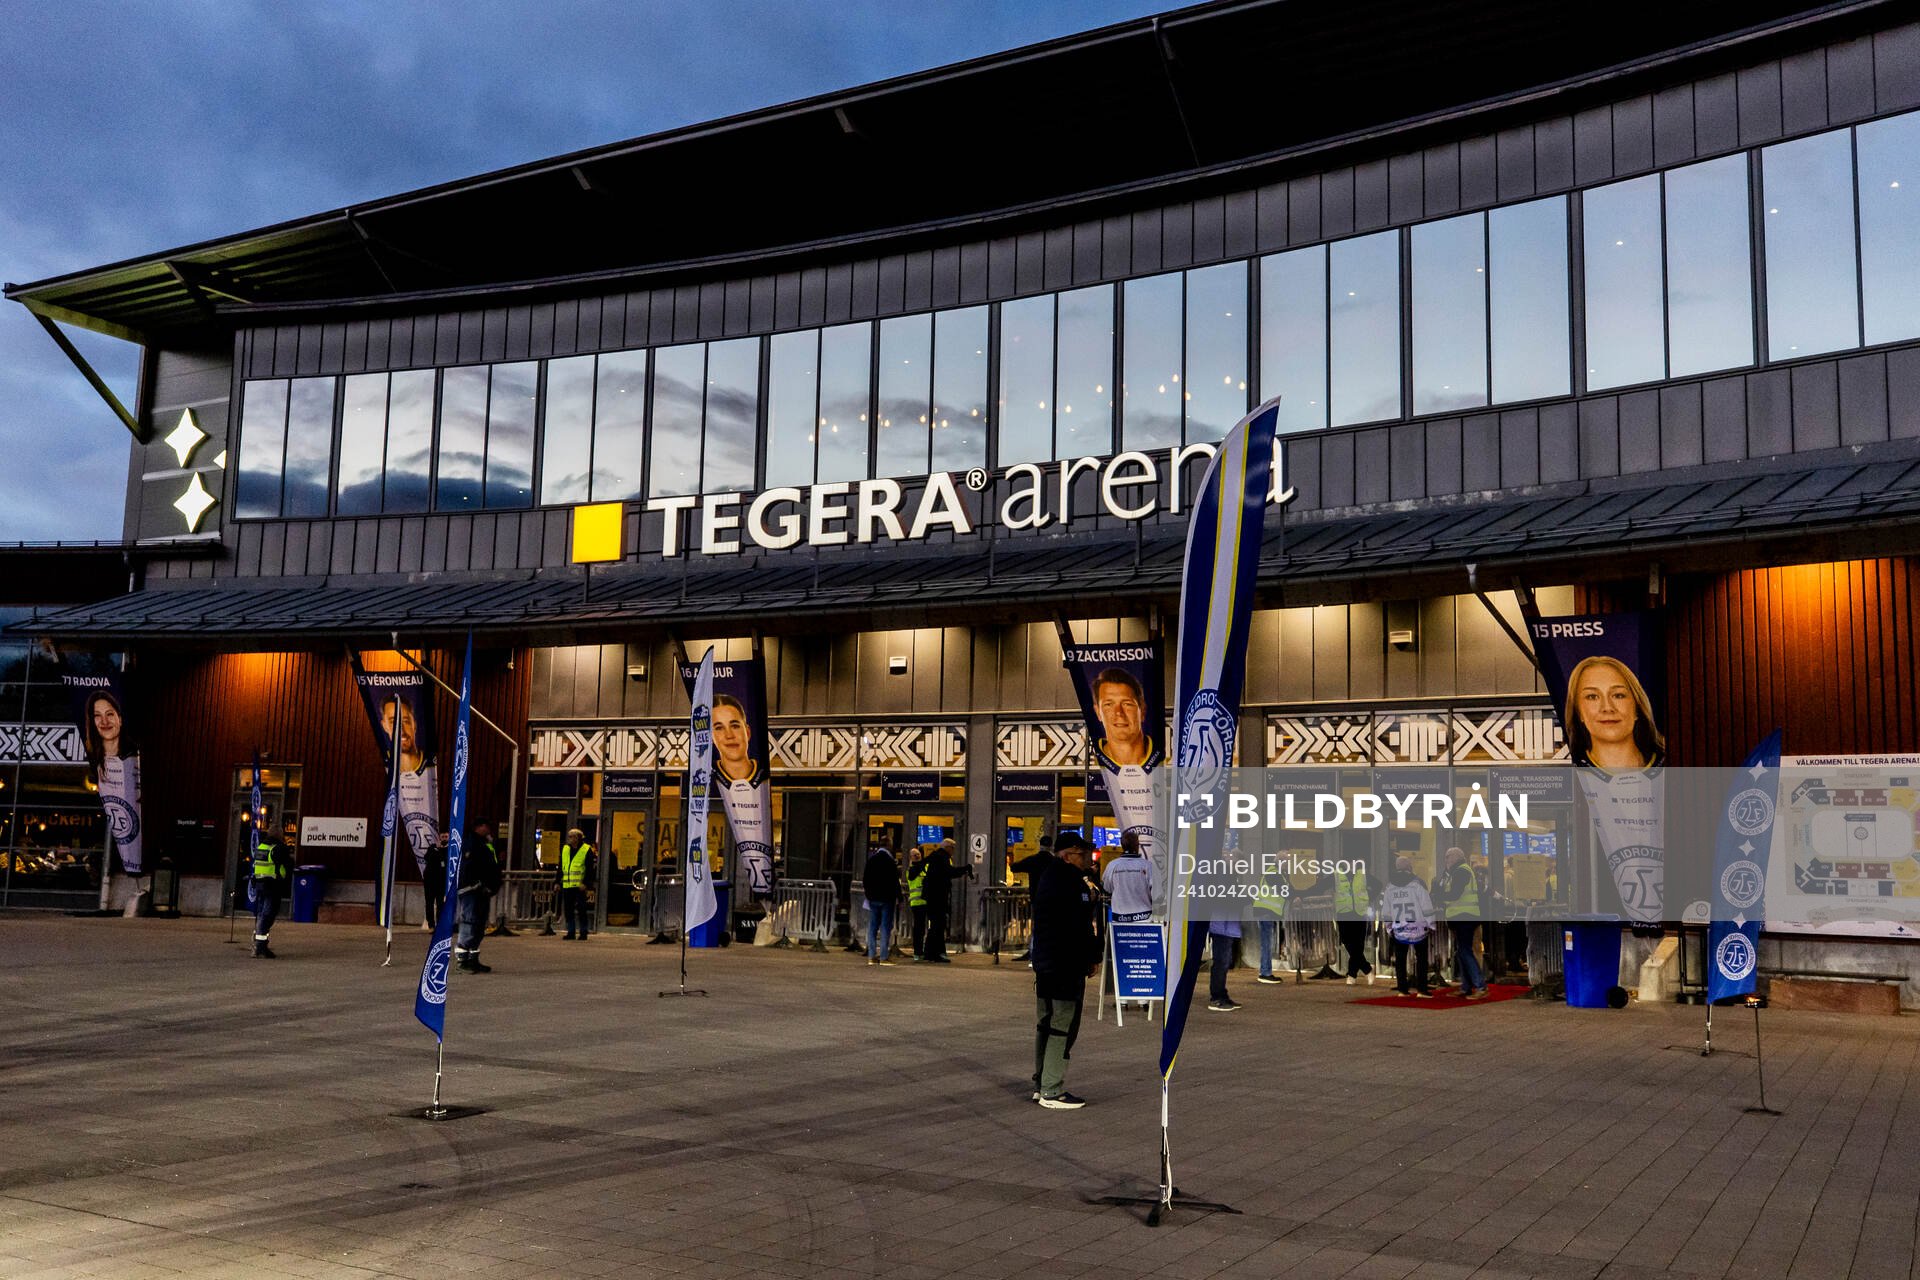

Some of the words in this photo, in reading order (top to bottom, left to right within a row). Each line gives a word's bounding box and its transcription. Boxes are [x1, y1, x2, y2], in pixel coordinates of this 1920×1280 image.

[1532, 623, 1549, 638] 15
[1551, 621, 1605, 638] PRESS
[1076, 647, 1154, 663] ZACKRISSON
[681, 667, 692, 678] 16
[73, 676, 111, 687] RADOVA
[366, 674, 424, 686] VÉRONNEAU
[1796, 758, 1842, 766] VÄLKOMMEN
[605, 784, 630, 793] Ståplats
[307, 833, 326, 842] puck
[329, 833, 359, 842] munthe
[975, 837, 982, 849] 4
[1392, 902, 1417, 924] 75
